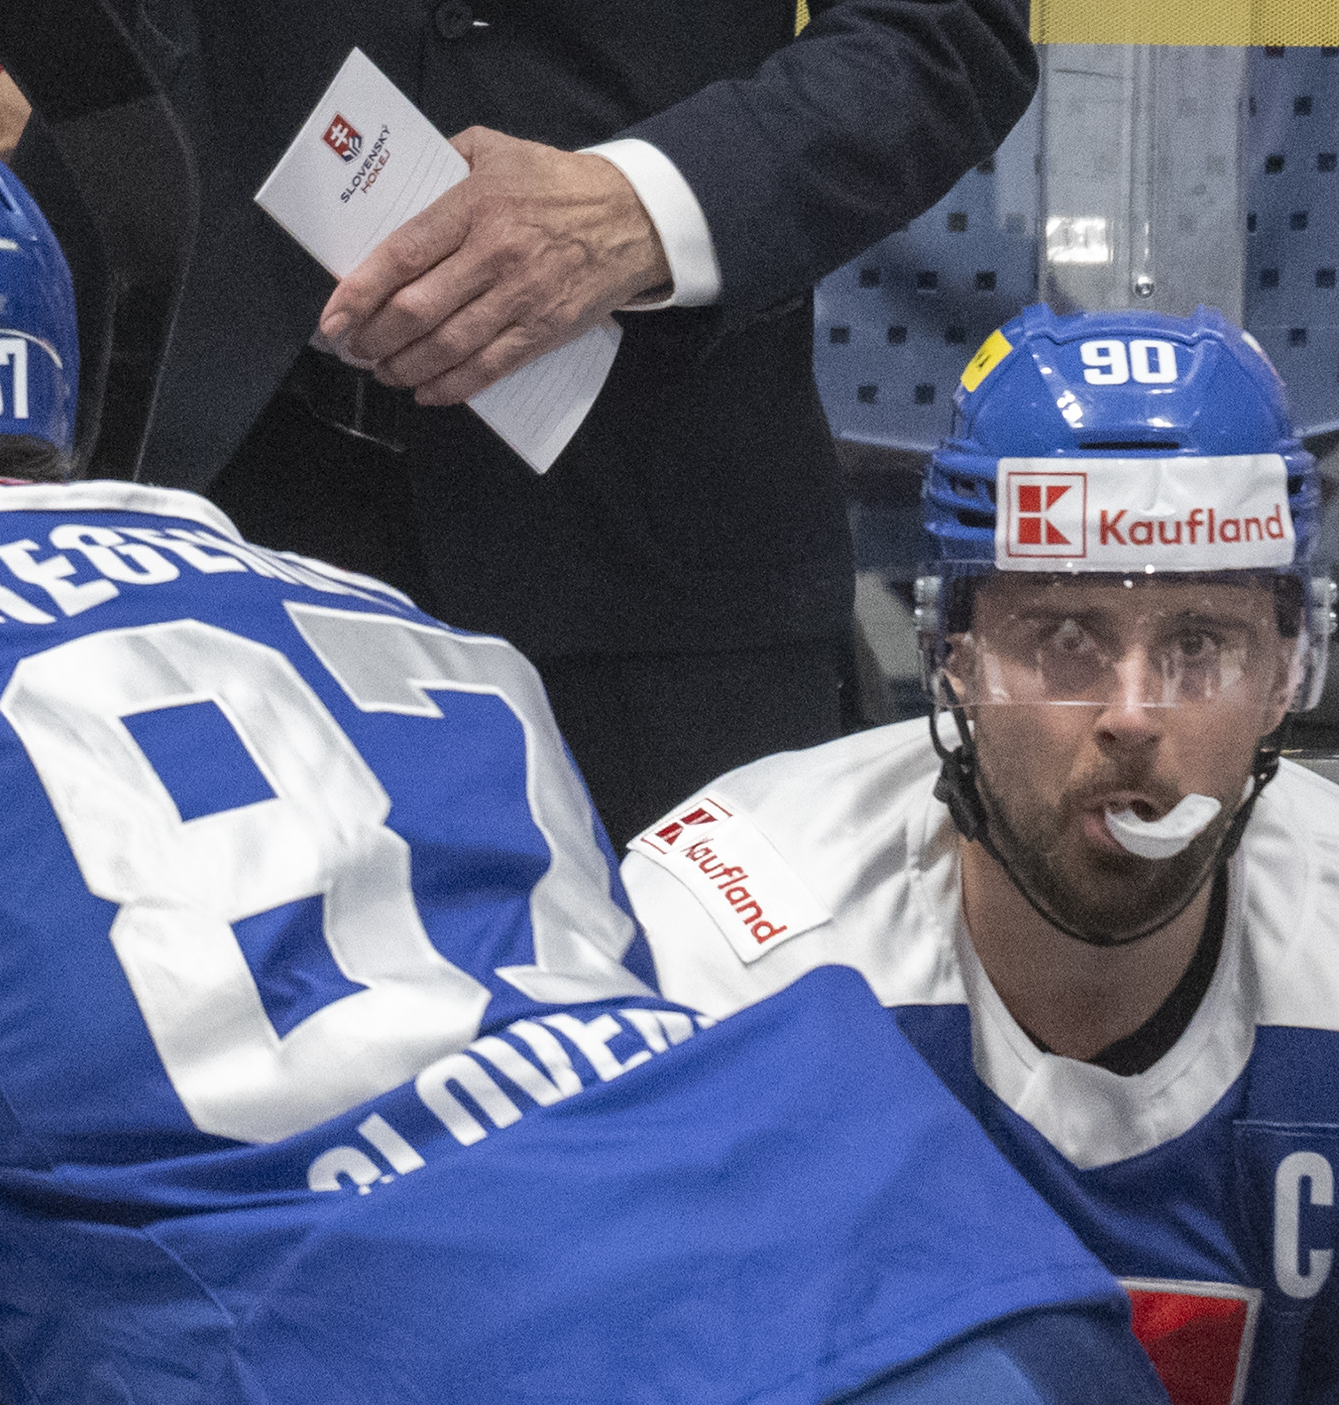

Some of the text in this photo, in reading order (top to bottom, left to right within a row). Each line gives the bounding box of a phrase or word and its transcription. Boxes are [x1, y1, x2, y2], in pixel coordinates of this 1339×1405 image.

[360, 149, 390, 194] HOKEJ
[1080, 339, 1178, 385] 90
[1099, 504, 1285, 547] Kaufland
[680, 836, 788, 944] Kaufland
[1275, 1151, 1334, 1299] C
